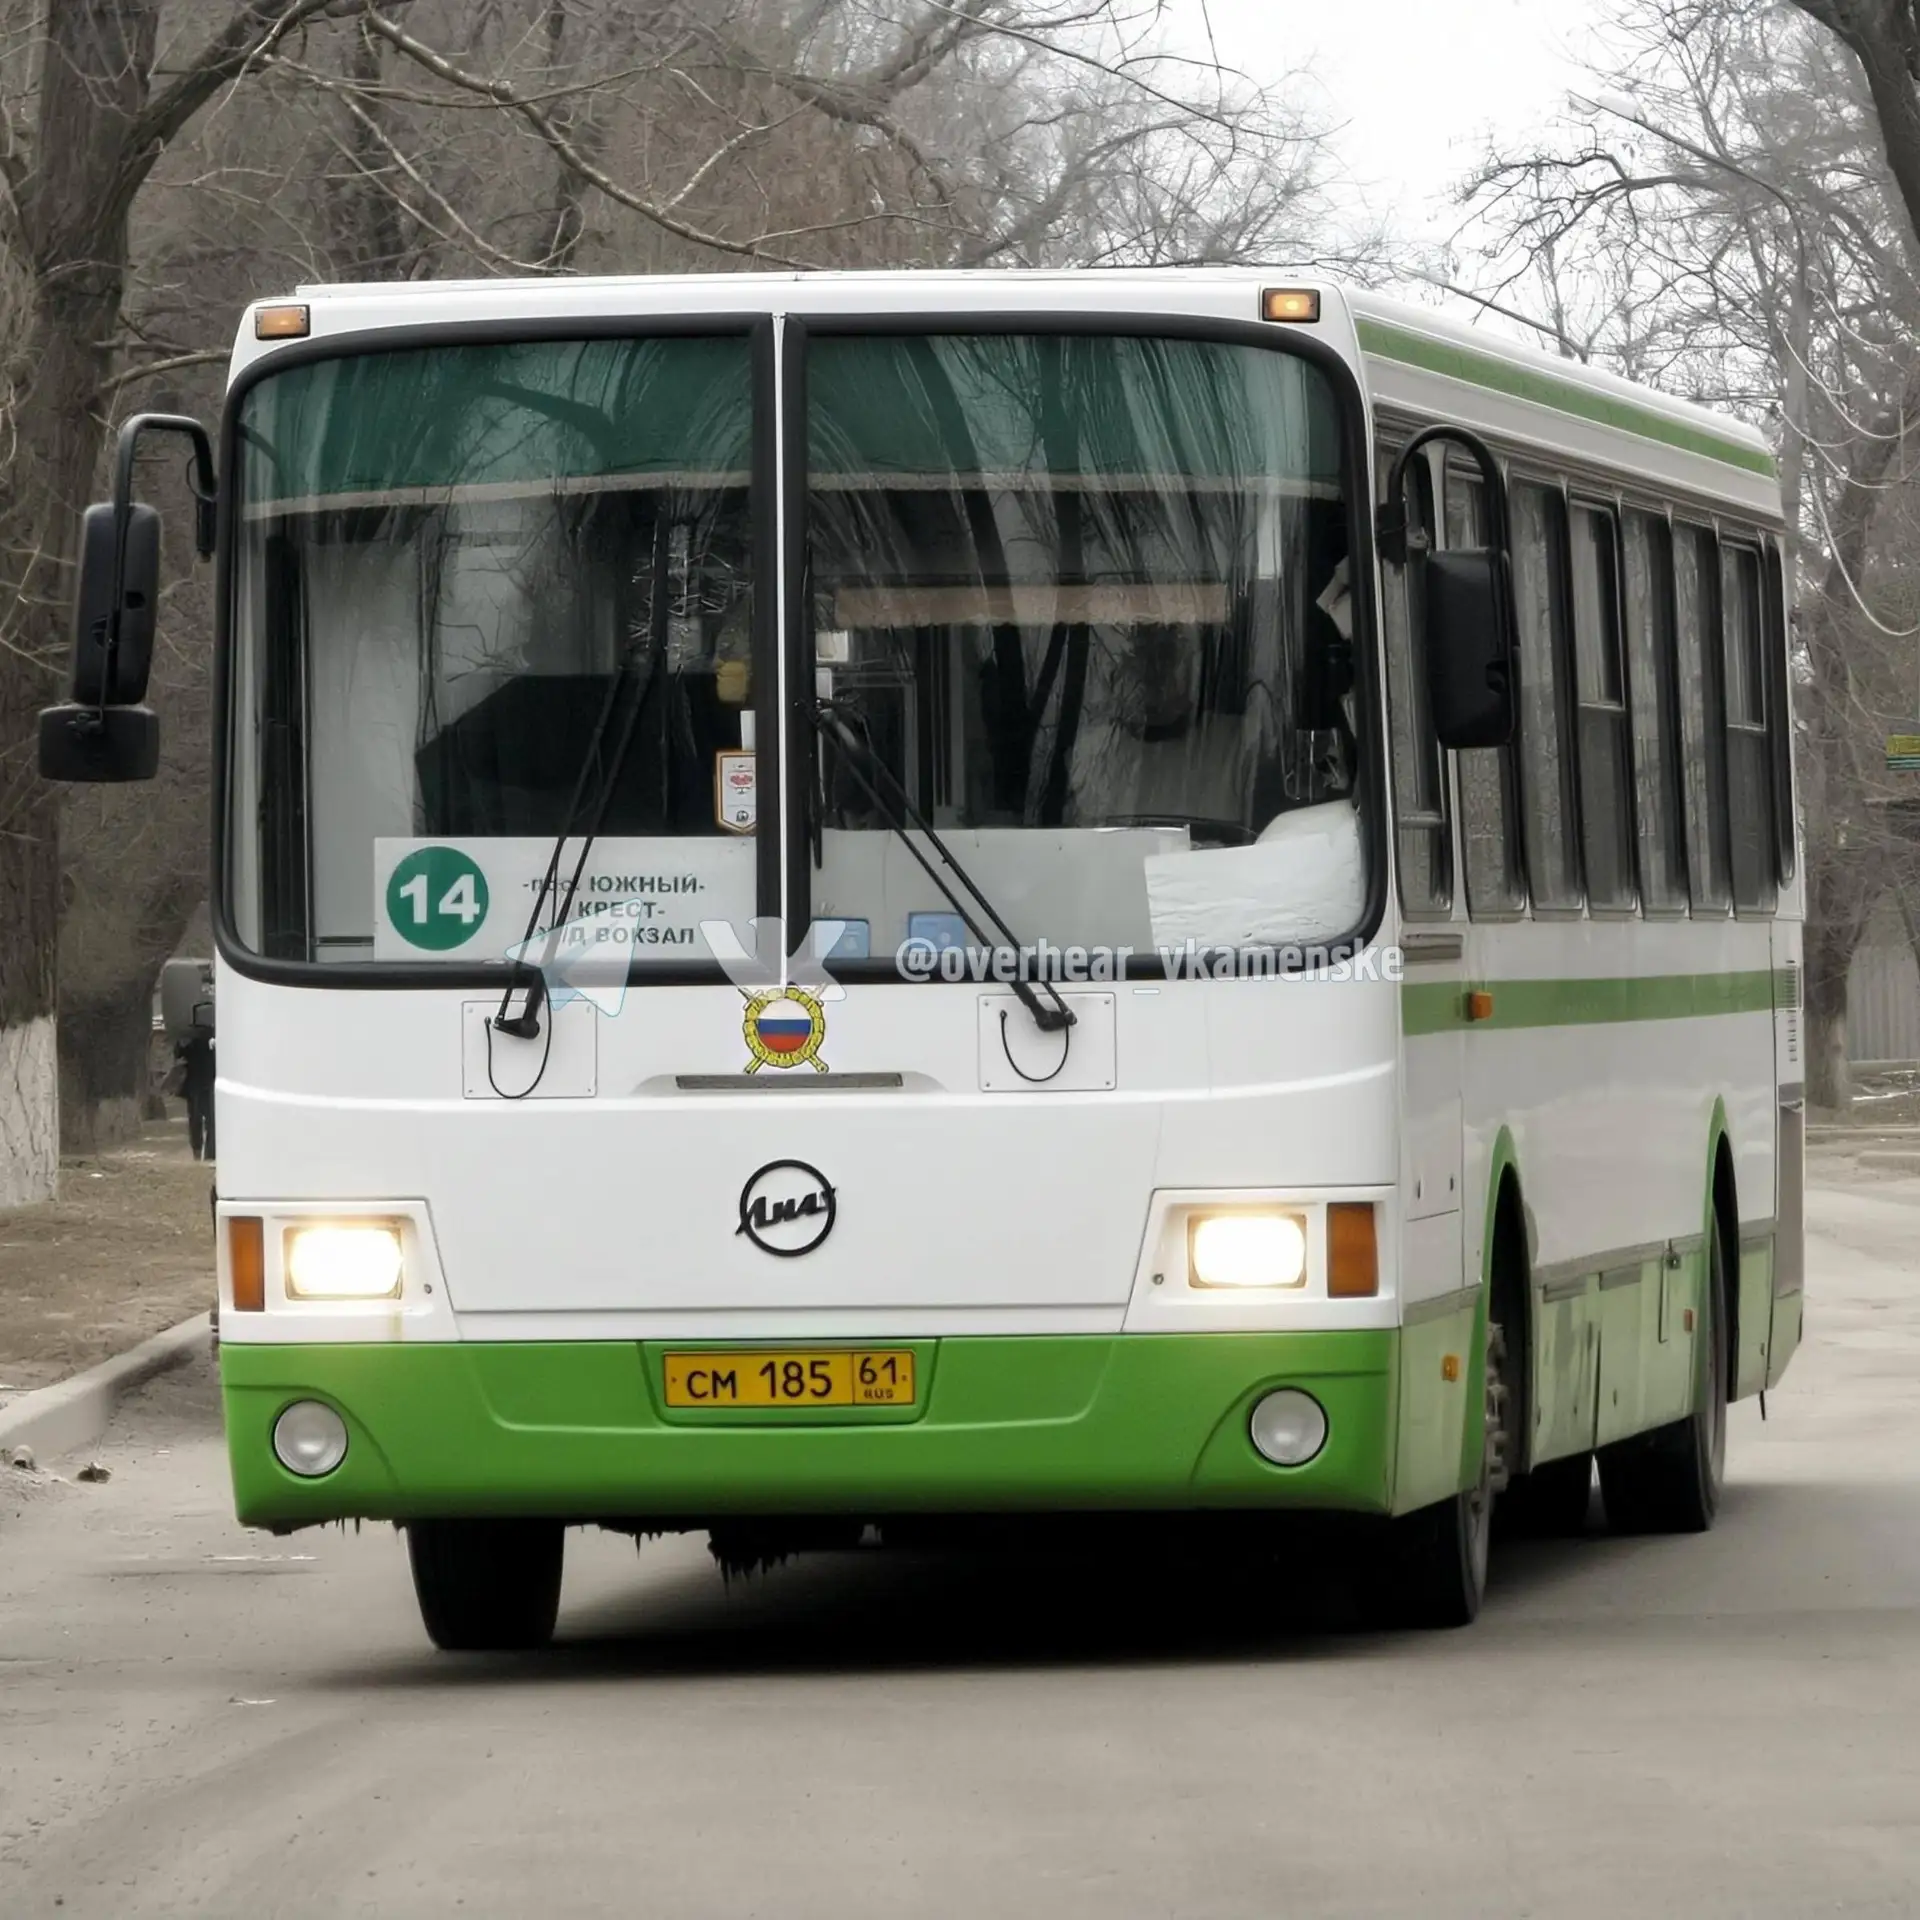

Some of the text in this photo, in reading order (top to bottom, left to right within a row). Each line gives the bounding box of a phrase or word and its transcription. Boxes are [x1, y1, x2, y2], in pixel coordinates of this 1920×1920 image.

[590, 874, 705, 893] ЮЖНЫЙ-
[400, 874, 480, 924] 14
[578, 901, 665, 919] КРЕСТ-
[595, 927, 695, 944] ВОКЗАЛ
[686, 1356, 896, 1399] СМ 185 61
[864, 1389, 894, 1399] RUS
